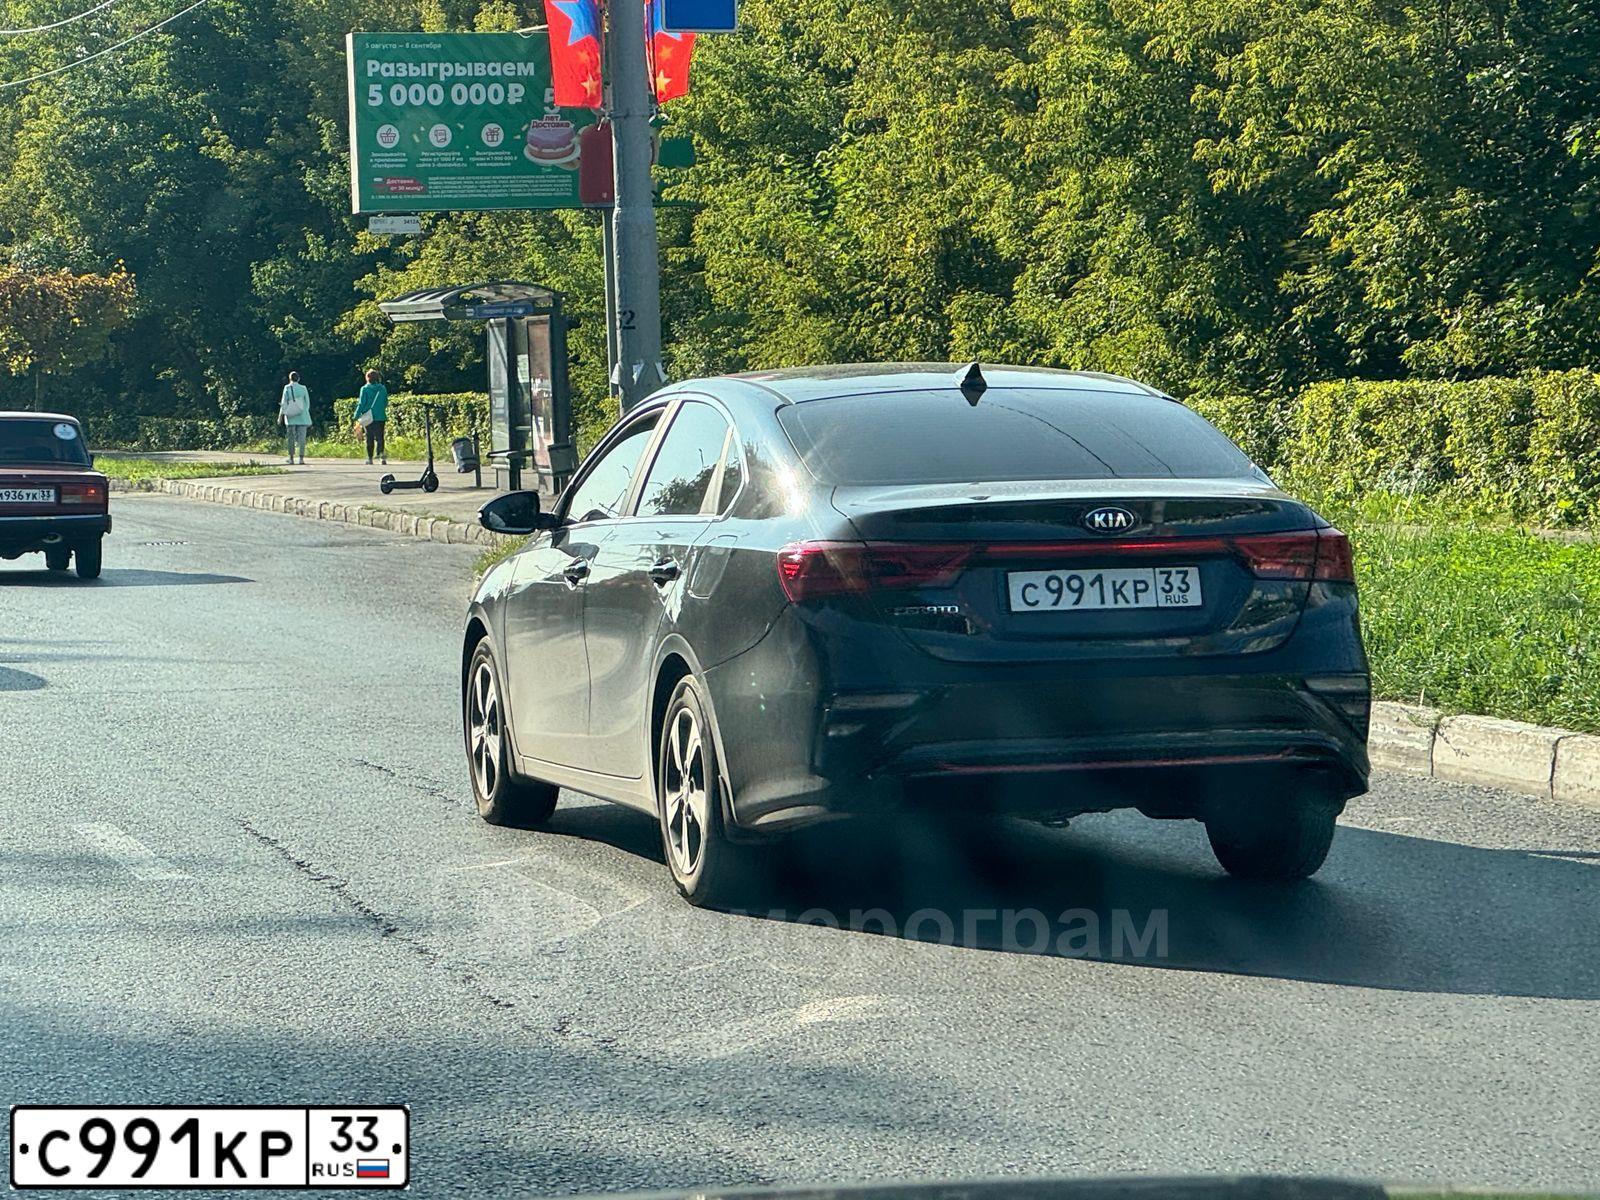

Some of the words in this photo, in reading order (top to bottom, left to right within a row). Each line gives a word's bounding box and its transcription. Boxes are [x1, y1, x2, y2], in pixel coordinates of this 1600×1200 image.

[366, 59, 535, 80] Разыгрываем
[368, 85, 383, 106] 5
[390, 84, 445, 106] 000
[41, 490, 51, 499] 33
[1094, 513, 1127, 528] KIA
[1021, 573, 1150, 607] С991КР
[1159, 569, 1191, 594] 33
[1165, 594, 1189, 604] RUS
